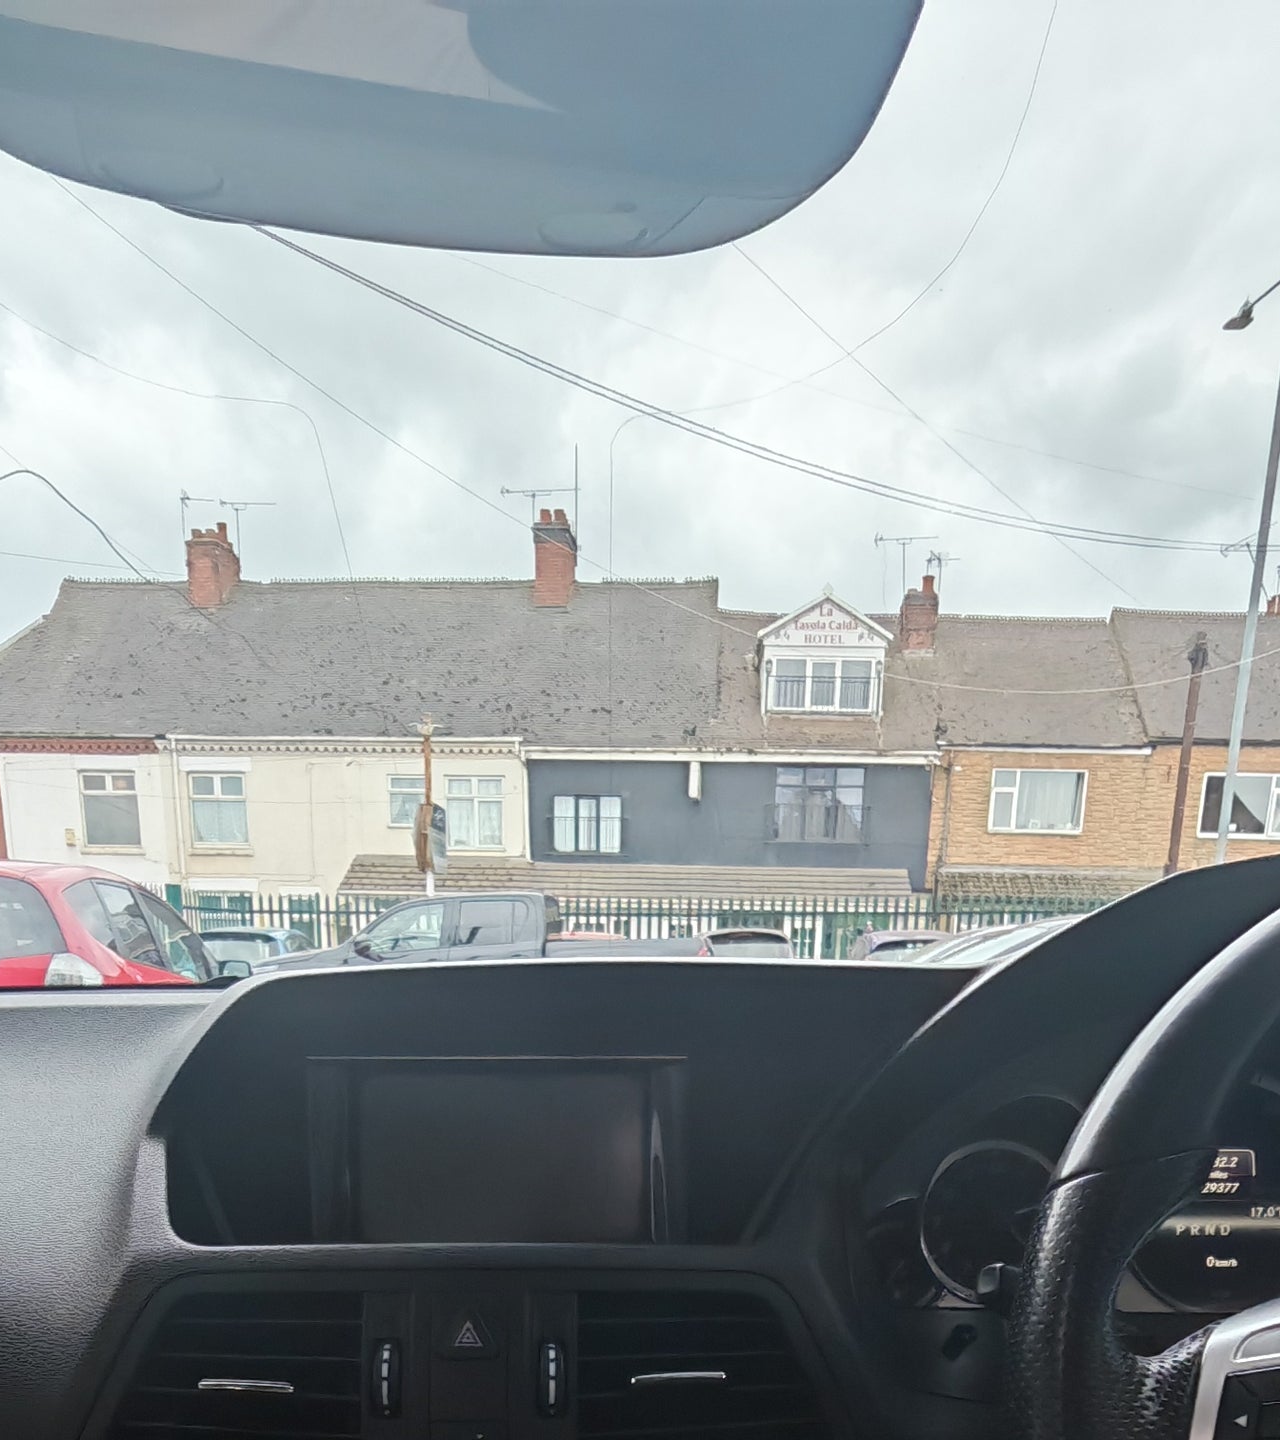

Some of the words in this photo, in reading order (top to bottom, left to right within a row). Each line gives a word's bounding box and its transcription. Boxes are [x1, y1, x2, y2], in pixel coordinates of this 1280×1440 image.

[819, 604, 833, 617] La
[804, 634, 845, 645] HOTEL
[1201, 1182, 1240, 1194] 29377
